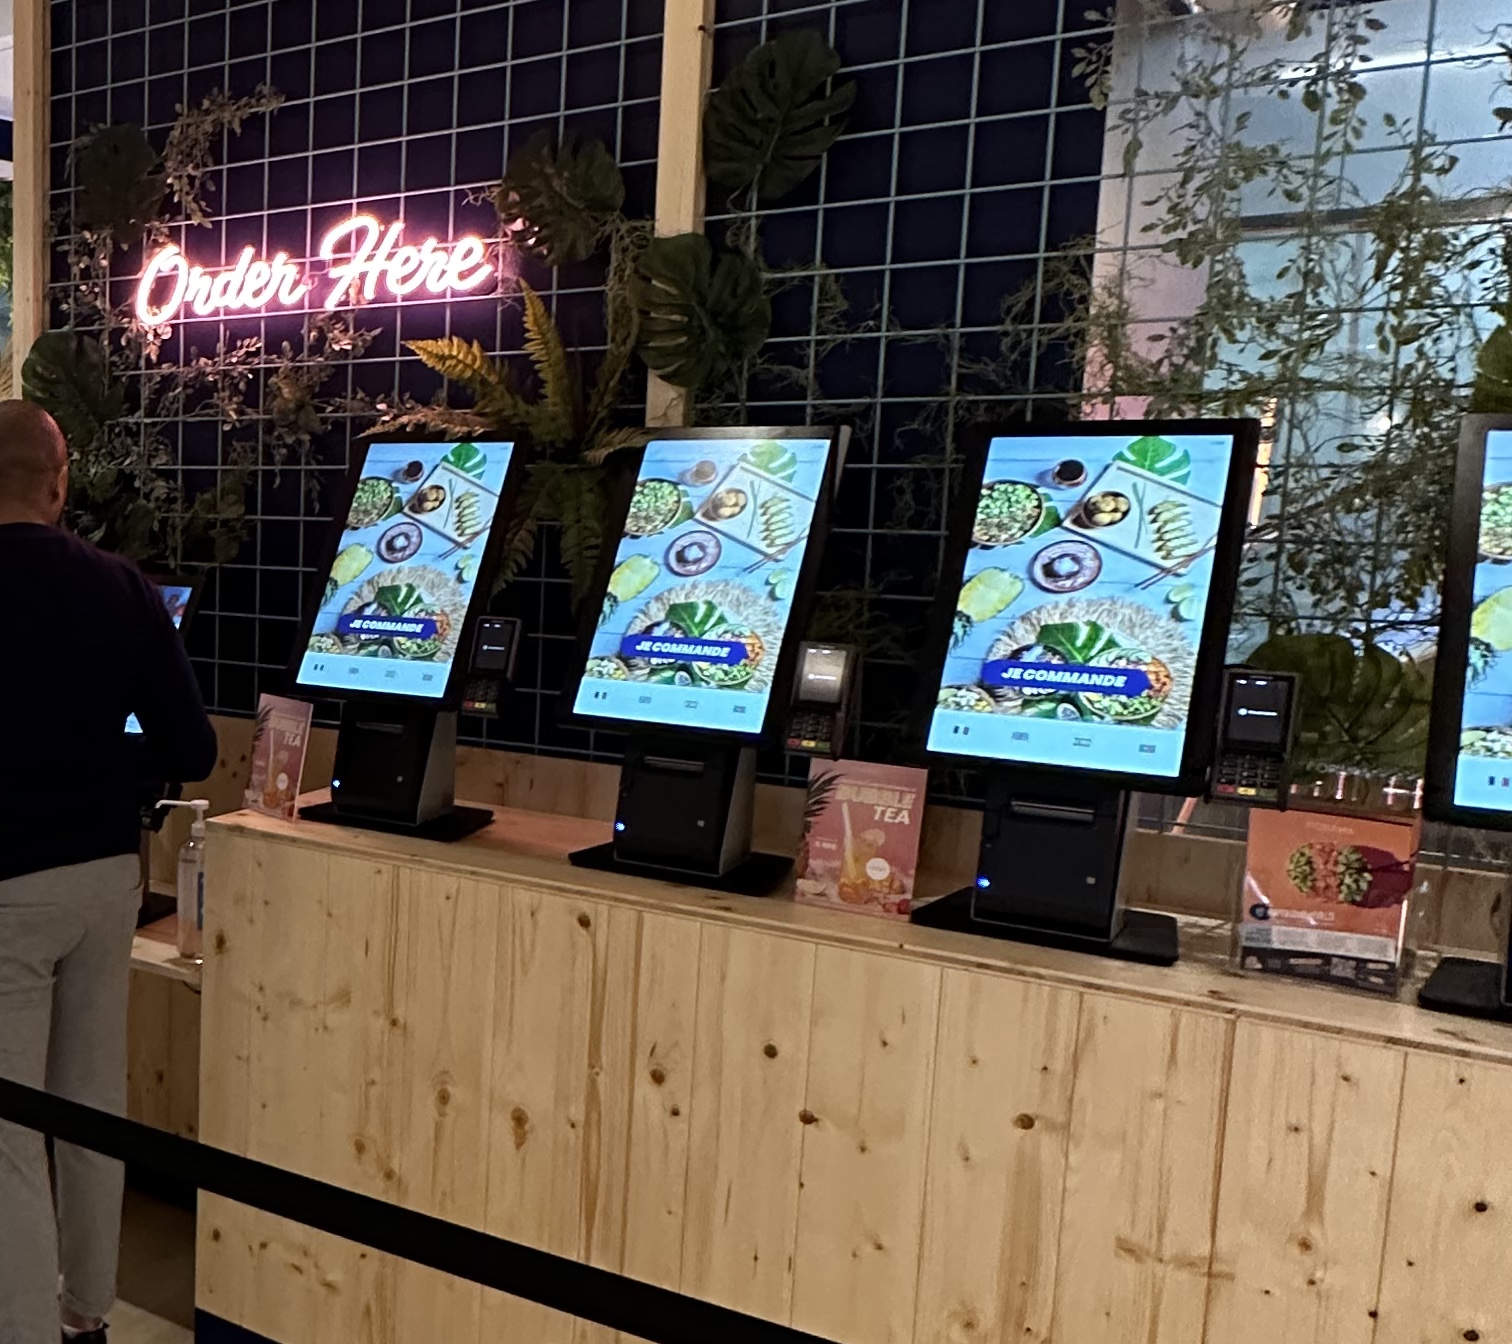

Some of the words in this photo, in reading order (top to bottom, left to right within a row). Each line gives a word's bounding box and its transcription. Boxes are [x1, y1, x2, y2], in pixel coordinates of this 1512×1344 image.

[134, 241, 308, 325] Order
[319, 214, 493, 309] Here
[362, 620, 424, 633] COMMANDE
[635, 640, 652, 652] JE
[652, 641, 731, 658] COMMANDE
[1001, 667, 1024, 679] JE
[1023, 668, 1128, 688] COMMANDE
[873, 804, 911, 825] TEA
